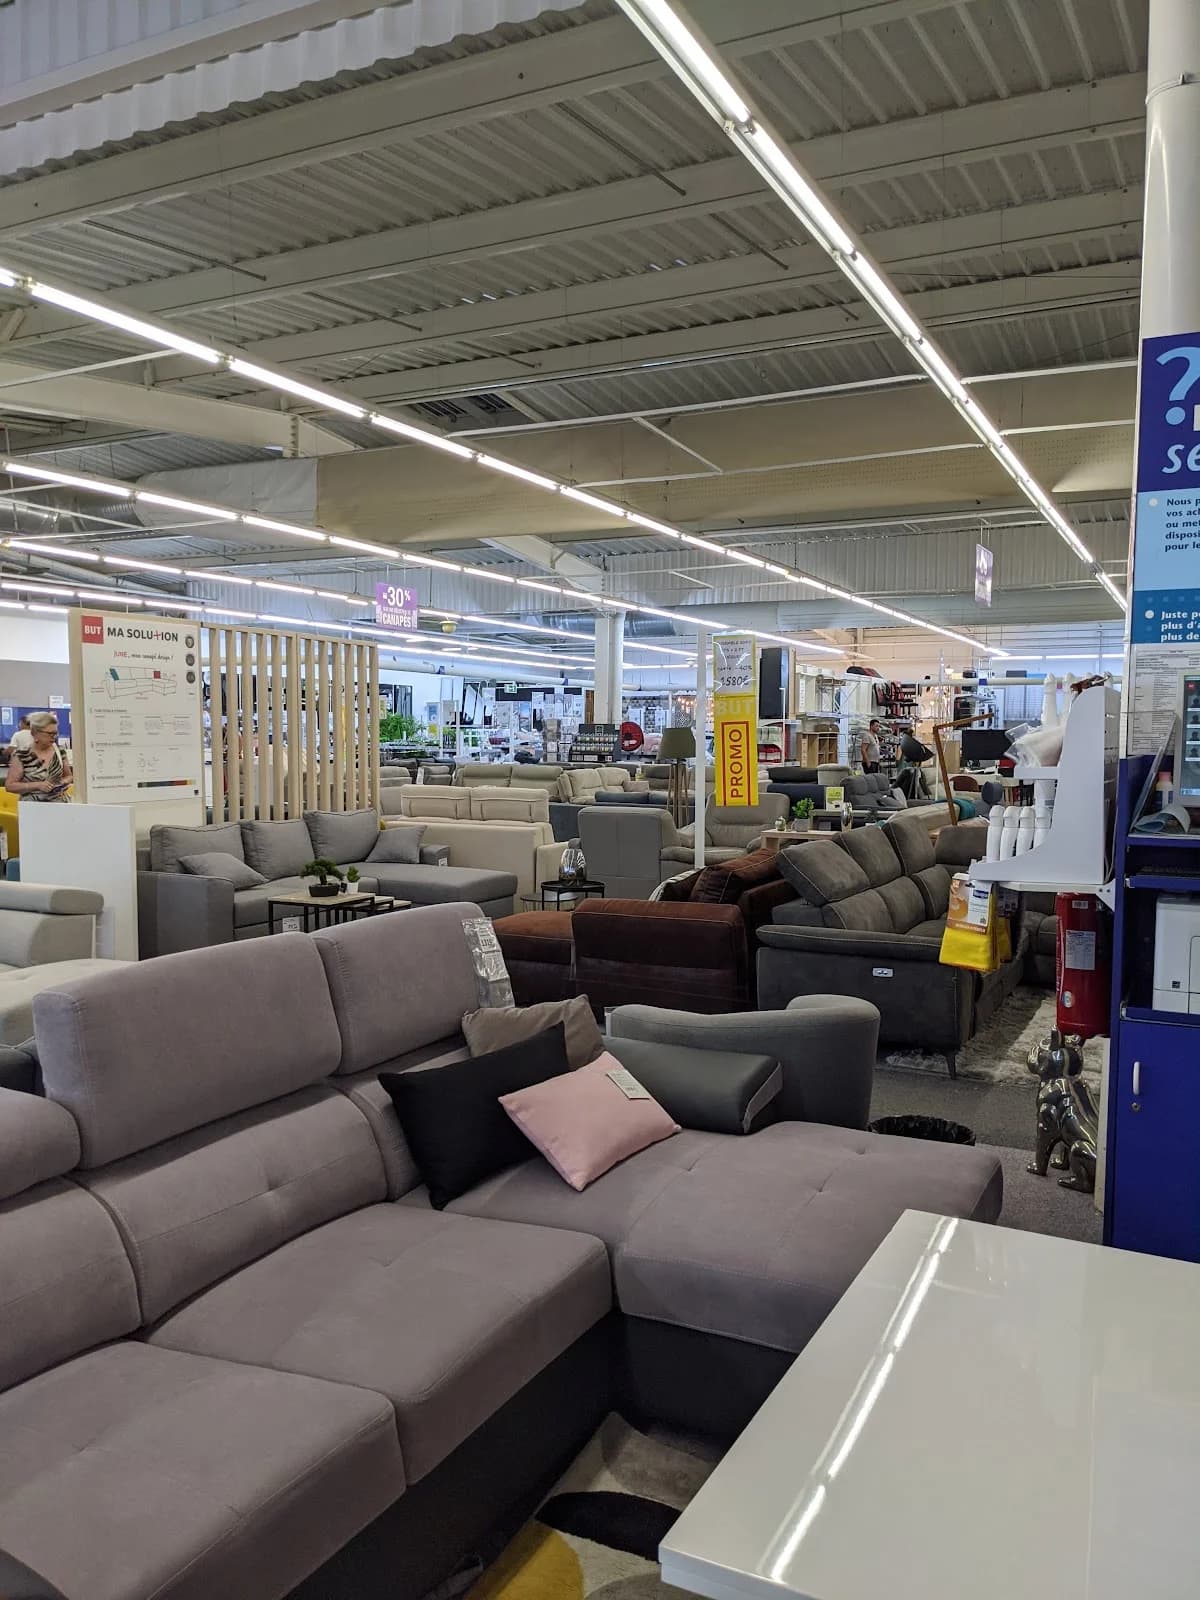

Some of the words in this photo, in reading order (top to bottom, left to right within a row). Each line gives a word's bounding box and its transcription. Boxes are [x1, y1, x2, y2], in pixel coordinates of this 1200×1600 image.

[1167, 498, 1192, 506] Nous
[1165, 543, 1189, 552] pour
[382, 612, 411, 628] CANAPÉS
[1161, 611, 1188, 620] Juste
[84, 624, 102, 635] BUT
[1161, 621, 1183, 632] plus
[107, 627, 124, 638] MA
[1161, 632, 1183, 643] plus
[717, 700, 755, 715] BUT
[729, 728, 743, 799] PROMO
